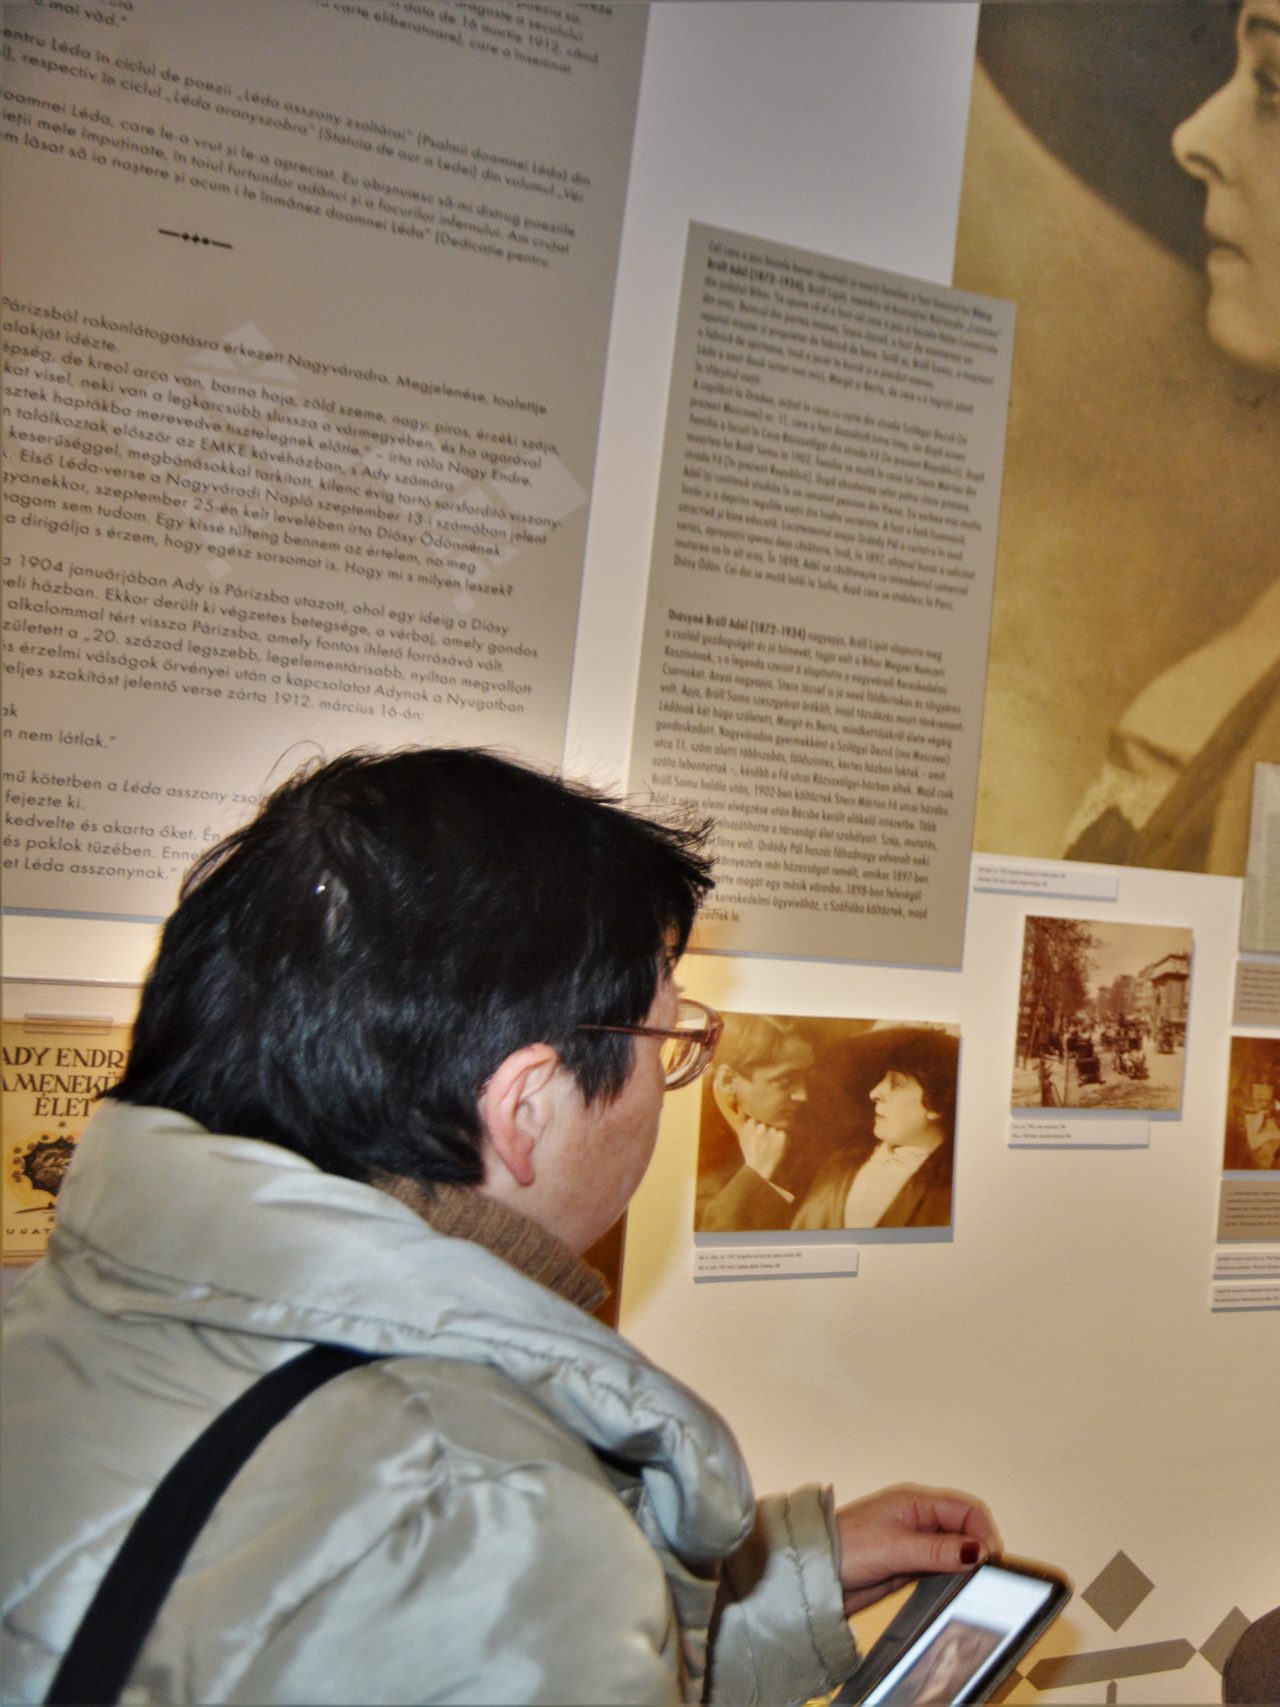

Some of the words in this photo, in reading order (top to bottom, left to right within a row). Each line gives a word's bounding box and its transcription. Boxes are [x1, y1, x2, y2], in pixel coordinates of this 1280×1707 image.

[2, 320, 61, 340] alakját
[82, 316, 219, 350] rokonlátogatásra
[222, 343, 284, 362] érkezett
[60, 352, 83, 366] de
[87, 355, 129, 374] kreol
[132, 368, 169, 382] arca
[210, 378, 256, 398] barna
[52, 391, 131, 416] haptákba
[136, 410, 222, 431] merevedve
[79, 378, 114, 392] neki
[118, 386, 148, 398] van
[167, 391, 261, 419] legkarcsúbb
[16, 408, 107, 432] találkoztak
[112, 424, 171, 443] először
[175, 437, 195, 448] az
[200, 438, 246, 456] EMKE
[18, 448, 53, 466] Első
[58, 456, 146, 481] Léda-verse
[165, 473, 260, 498] Nagyváradi
[127, 449, 251, 476] megbánásokkal
[61, 501, 93, 513] sem
[155, 512, 184, 530] Egy
[188, 517, 225, 534] kissé
[95, 486, 186, 507] szeptember
[193, 497, 238, 515] 25-én
[242, 505, 269, 519] kelt
[20, 514, 90, 535] dirigálja
[163, 534, 203, 554] hogy
[206, 544, 251, 559] egész
[20, 554, 63, 572] 1904
[68, 566, 167, 586] januárjában
[171, 577, 204, 594] Ady
[208, 585, 220, 595] is
[224, 583, 290, 604] Párizsba
[7, 598, 104, 620] alkalommal
[108, 611, 136, 624] tért
[139, 618, 187, 631] vissza
[104, 588, 148, 605] Ekkor
[152, 595, 199, 611] derült
[202, 600, 216, 614] ki
[219, 607, 287, 624] végzetes
[124, 636, 183, 651] század
[18, 643, 81, 659] érzelmi
[85, 651, 157, 670] válságok
[162, 660, 230, 678] örvényei
[234, 670, 267, 681] után
[48, 669, 119, 685] szakítást
[122, 676, 177, 692] jelentő
[181, 685, 223, 698] verse
[226, 690, 267, 703] zárta
[17, 730, 53, 742] nem
[1, 770, 26, 783] mű
[30, 770, 102, 789] kötetben
[122, 780, 162, 795] Léda
[165, 788, 227, 803] asszony
[231, 791, 262, 806] zso
[4, 790, 62, 807] fejezte
[4, 812, 75, 830] kedvelte
[79, 819, 98, 832] és
[101, 820, 155, 837] akarta
[1, 837, 21, 848] és
[25, 837, 82, 852] poklok
[23, 857, 64, 872] Léda
[33, 1093, 93, 1117] ÉLET
